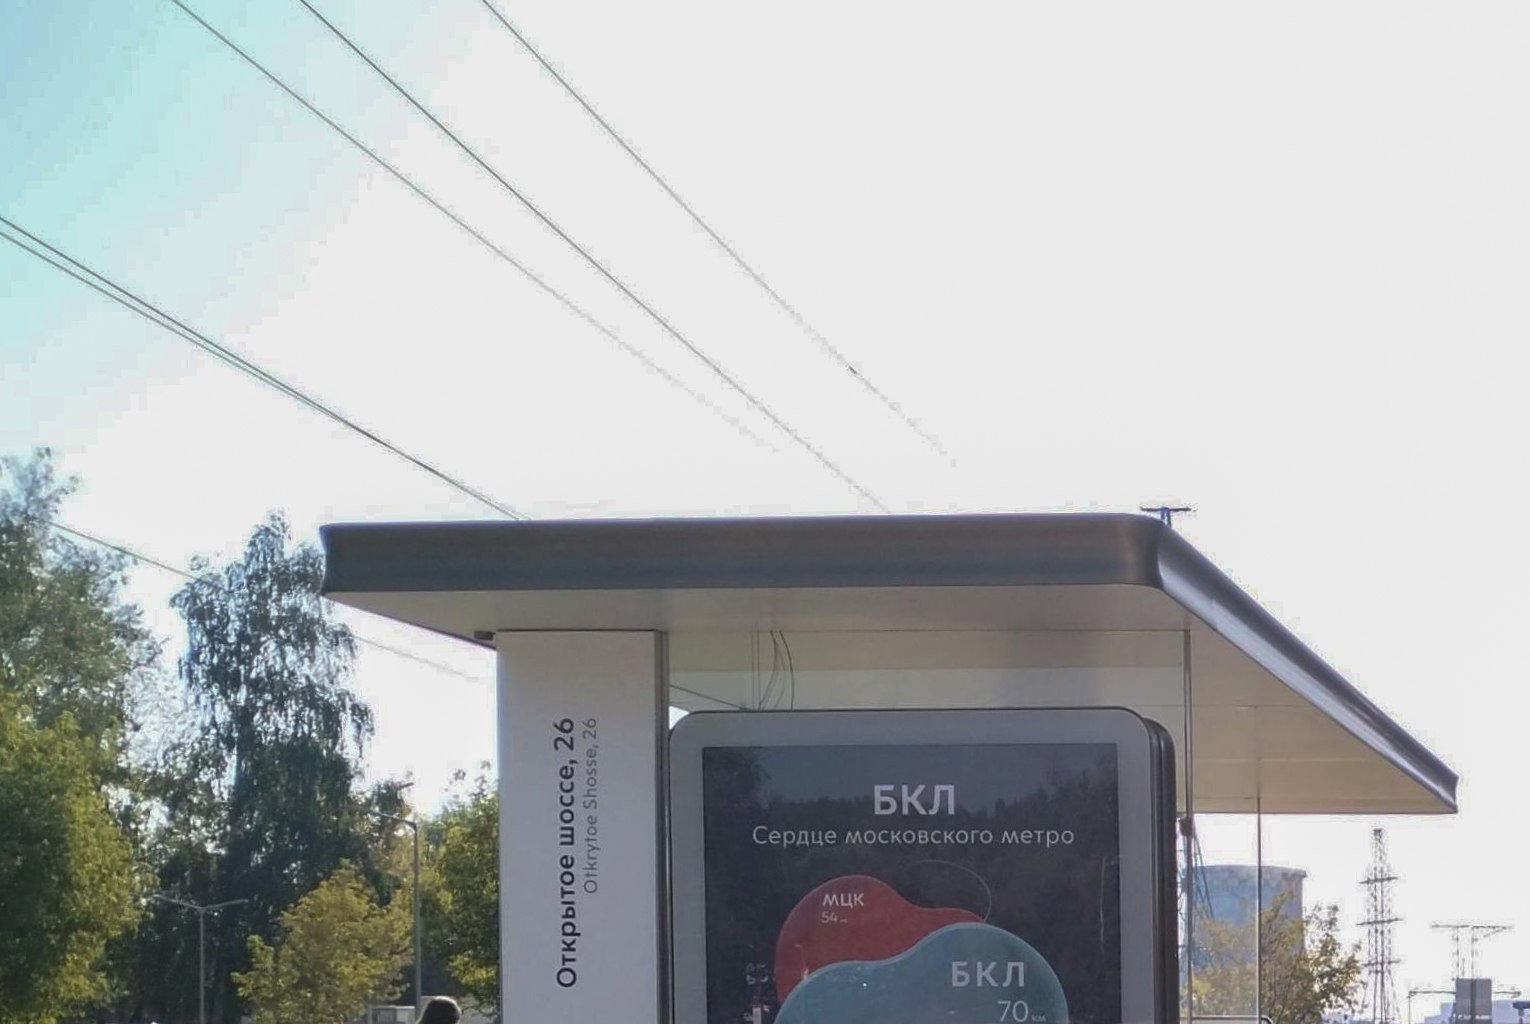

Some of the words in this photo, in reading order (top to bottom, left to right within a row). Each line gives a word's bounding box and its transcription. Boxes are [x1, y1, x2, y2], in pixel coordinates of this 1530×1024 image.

[553, 717, 575, 751] 26
[582, 717, 597, 740] 26
[582, 743, 600, 810] Shosse,
[559, 758, 580, 847] шоссе,
[873, 784, 955, 815] БКЛ
[752, 825, 837, 847] Сердце
[845, 829, 993, 844] московского
[1001, 829, 1075, 848] метро
[583, 812, 600, 894] Otkrytoe
[822, 893, 865, 909] МЦК
[556, 854, 581, 988] Открытое
[821, 911, 838, 924] 54
[951, 961, 1025, 987] БКЛ
[997, 1000, 1029, 1022] 70
